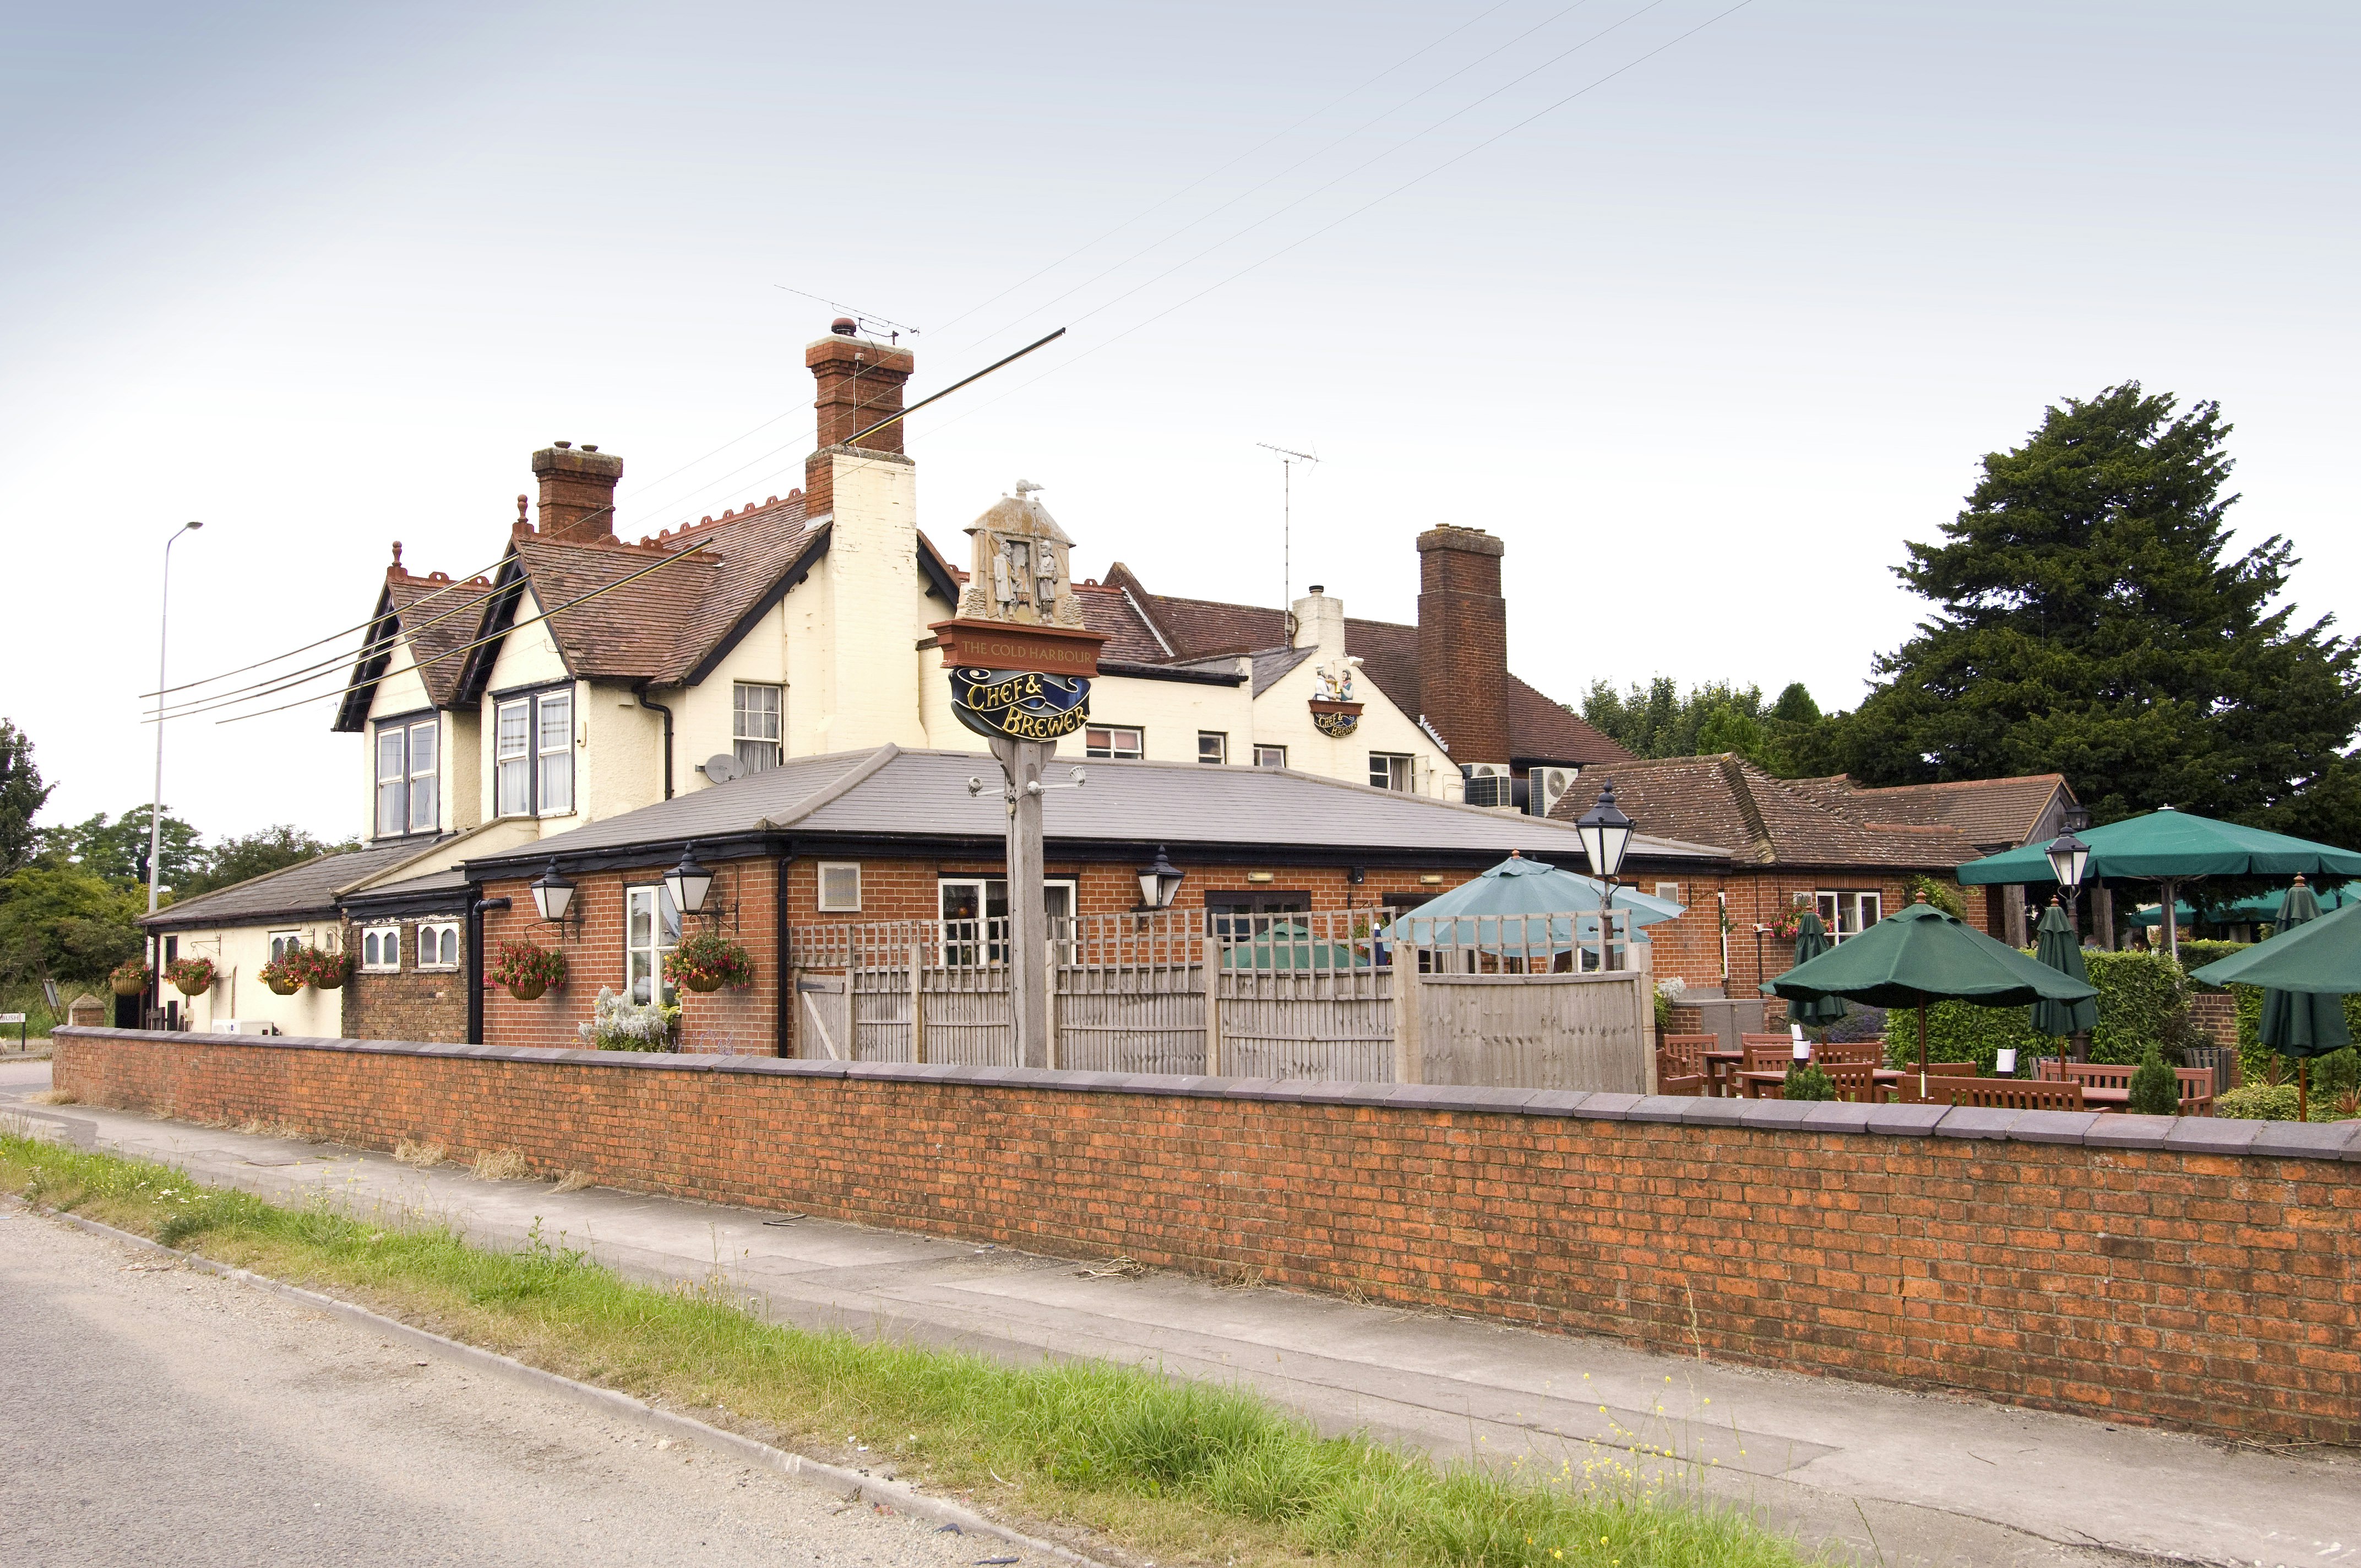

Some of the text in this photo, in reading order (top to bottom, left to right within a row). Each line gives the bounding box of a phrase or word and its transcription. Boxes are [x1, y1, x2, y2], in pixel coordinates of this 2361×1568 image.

[962, 641, 1092, 664] THE COLD HARBOUR
[967, 674, 1042, 711] CHEF &
[1002, 706, 1089, 737] BREWER
[1319, 715, 1336, 727] CHEF
[1331, 722, 1358, 736] BREWER
